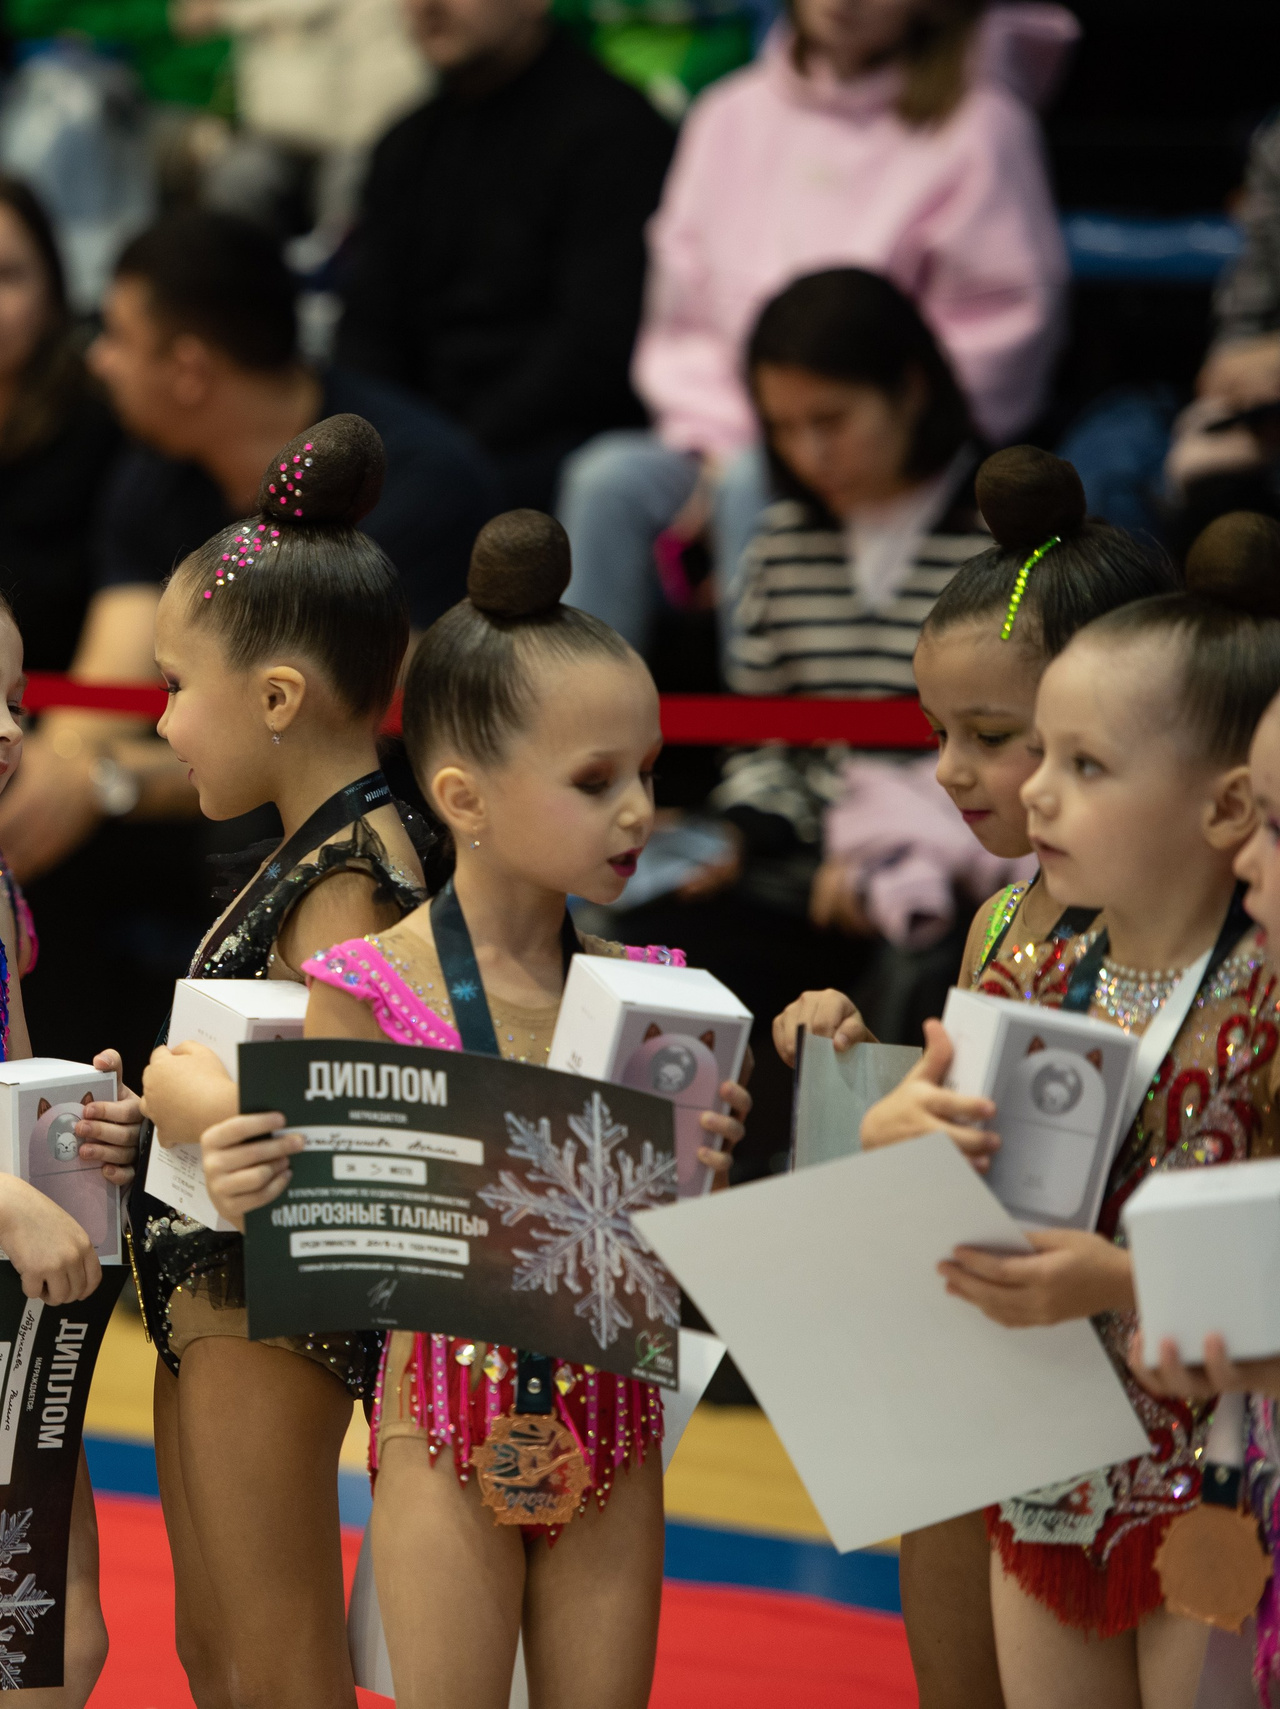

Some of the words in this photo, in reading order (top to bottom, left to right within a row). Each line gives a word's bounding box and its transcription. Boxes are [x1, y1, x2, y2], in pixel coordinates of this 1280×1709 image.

[304, 1060, 448, 1107] ДИПЛОМ
[271, 1202, 388, 1228] «МОРОЗНЫЕ
[389, 1205, 490, 1238] ТАЛАНТЫ»
[37, 1317, 89, 1449] ДИПЛОМ
